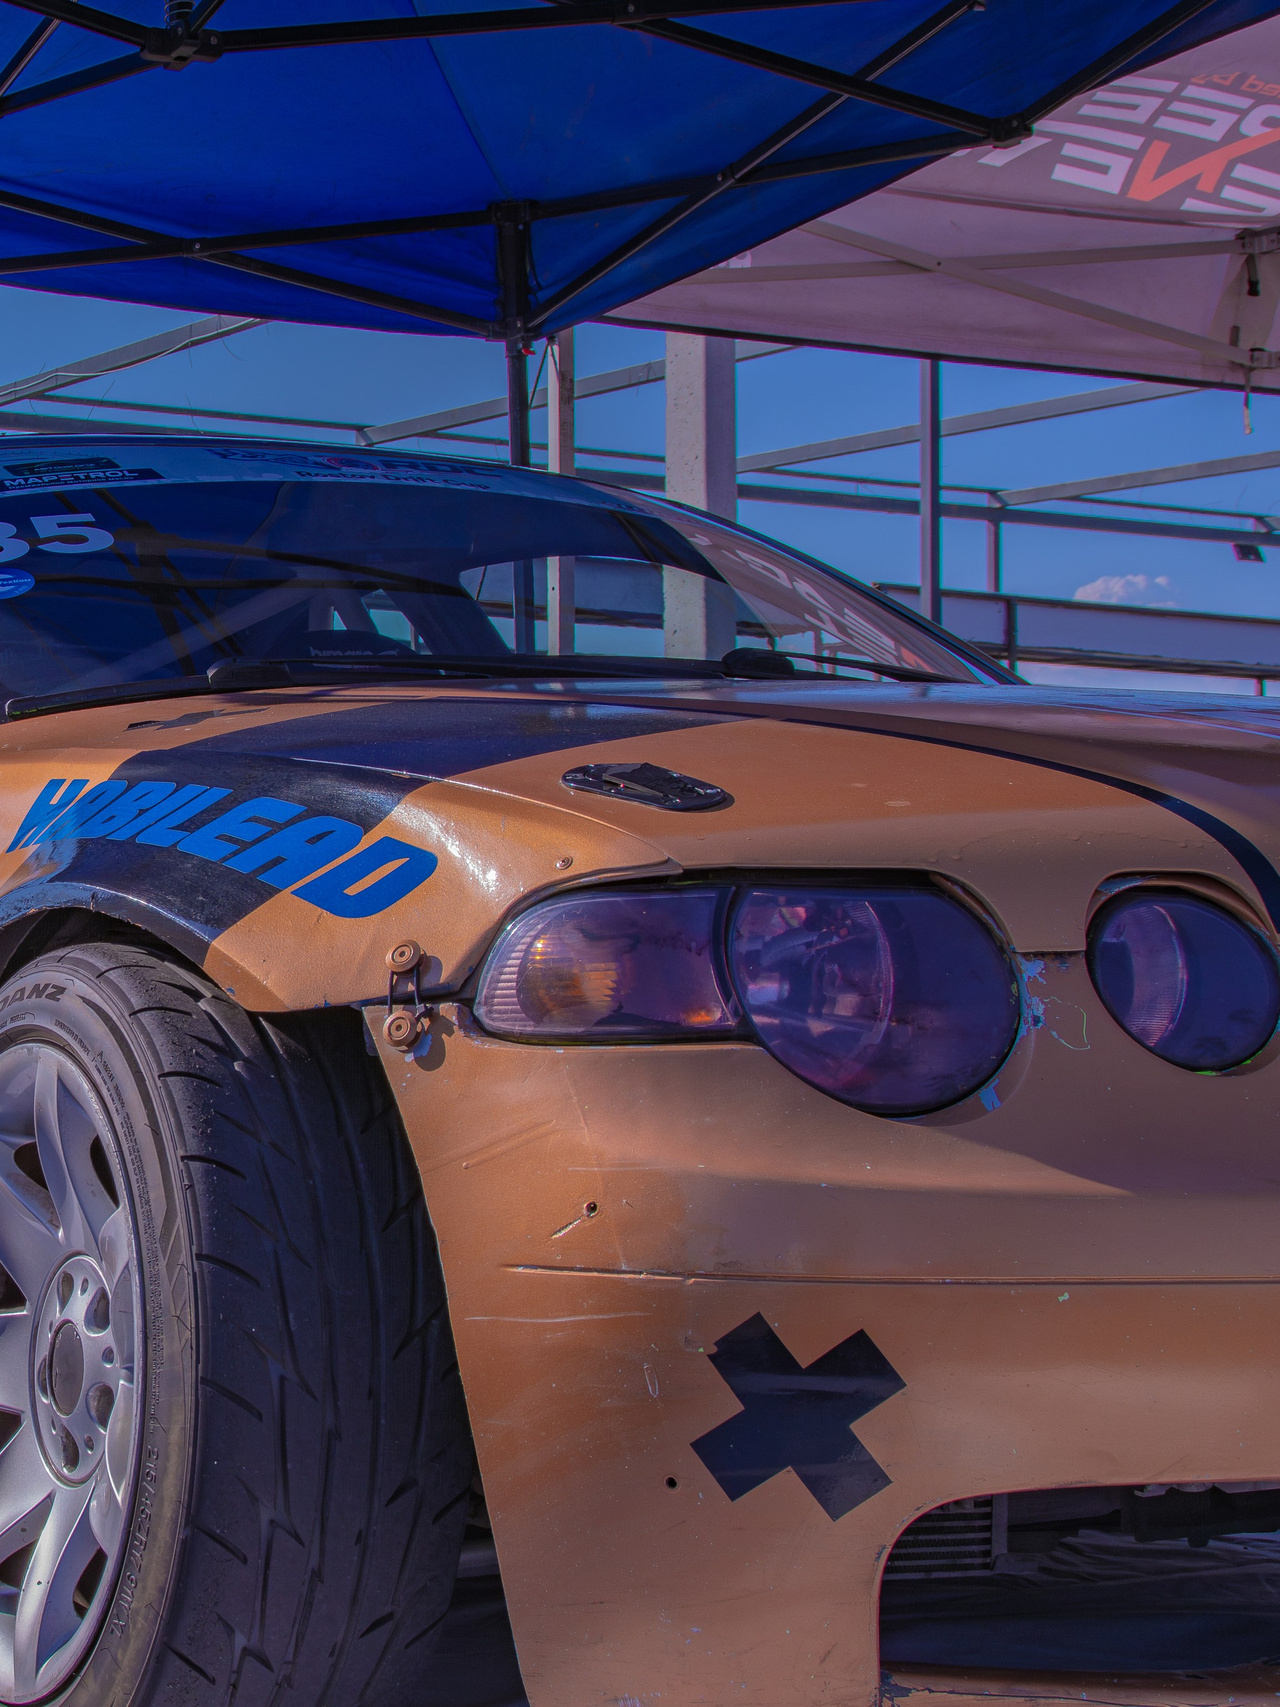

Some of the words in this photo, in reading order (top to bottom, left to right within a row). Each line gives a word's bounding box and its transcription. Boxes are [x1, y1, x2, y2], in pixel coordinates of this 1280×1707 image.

[3, 469, 139, 487] MAPETROL
[294, 470, 376, 480] Rostov
[385, 474, 435, 486] Drift
[441, 478, 491, 491] Cup
[6, 778, 438, 918] HABILEAD
